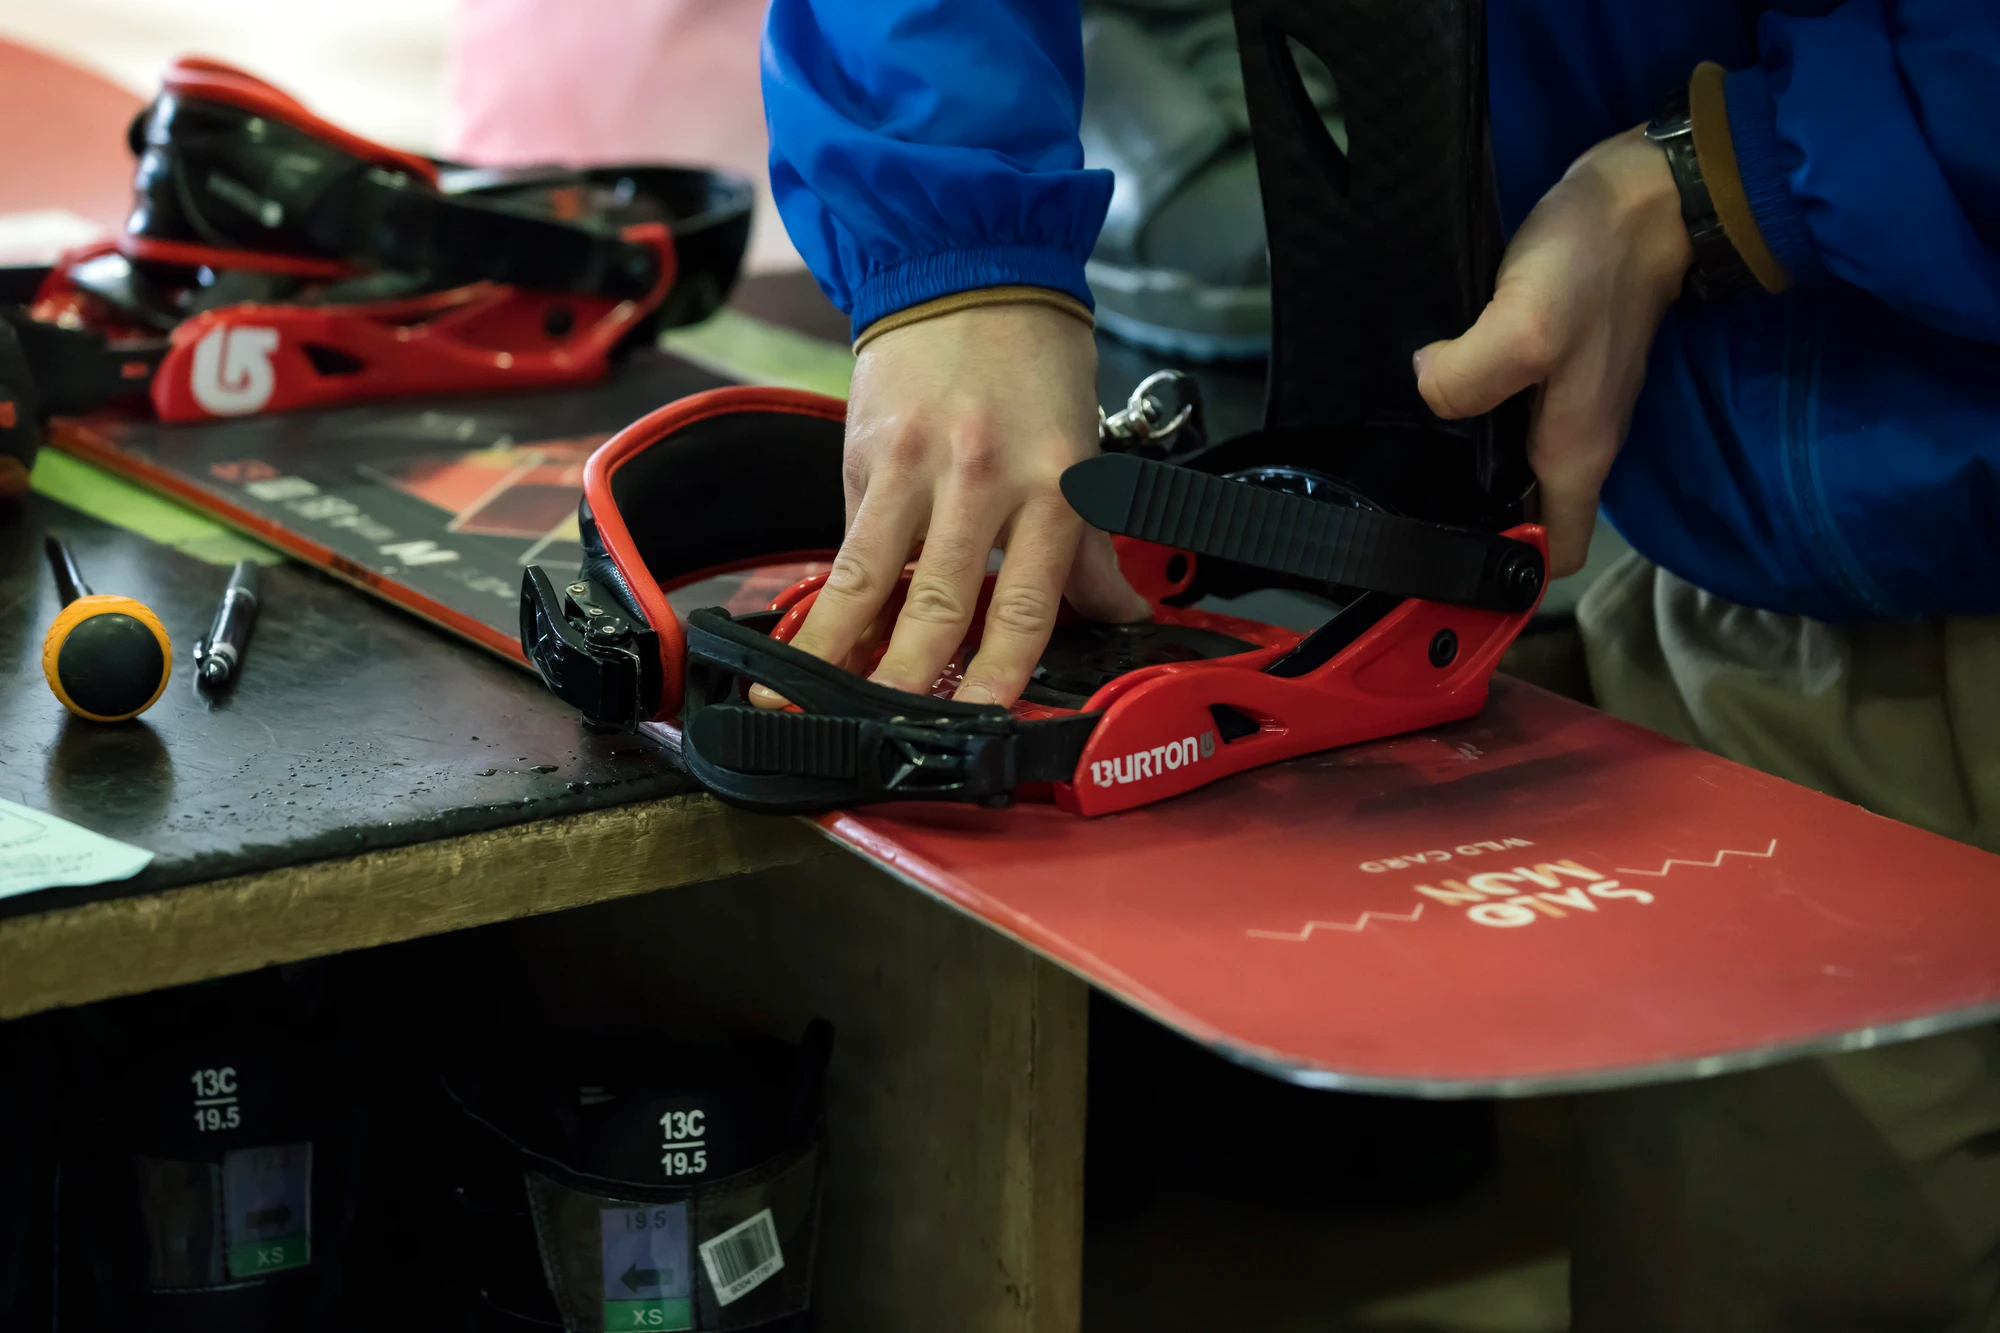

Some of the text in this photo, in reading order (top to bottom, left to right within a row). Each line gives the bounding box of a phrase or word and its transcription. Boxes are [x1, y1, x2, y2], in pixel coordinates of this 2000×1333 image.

[1090, 735, 1199, 788] BURTON
[1358, 835, 1534, 874] WILD CARD
[1465, 879, 1655, 929] SALO
[191, 1066, 238, 1098] 13C
[194, 1106, 241, 1132] 19.5
[659, 1109, 706, 1140] 13C
[661, 1150, 707, 1176] 19.5
[624, 1210, 667, 1231] 19.5
[257, 1247, 284, 1267] XS
[632, 1308, 664, 1326] XS
